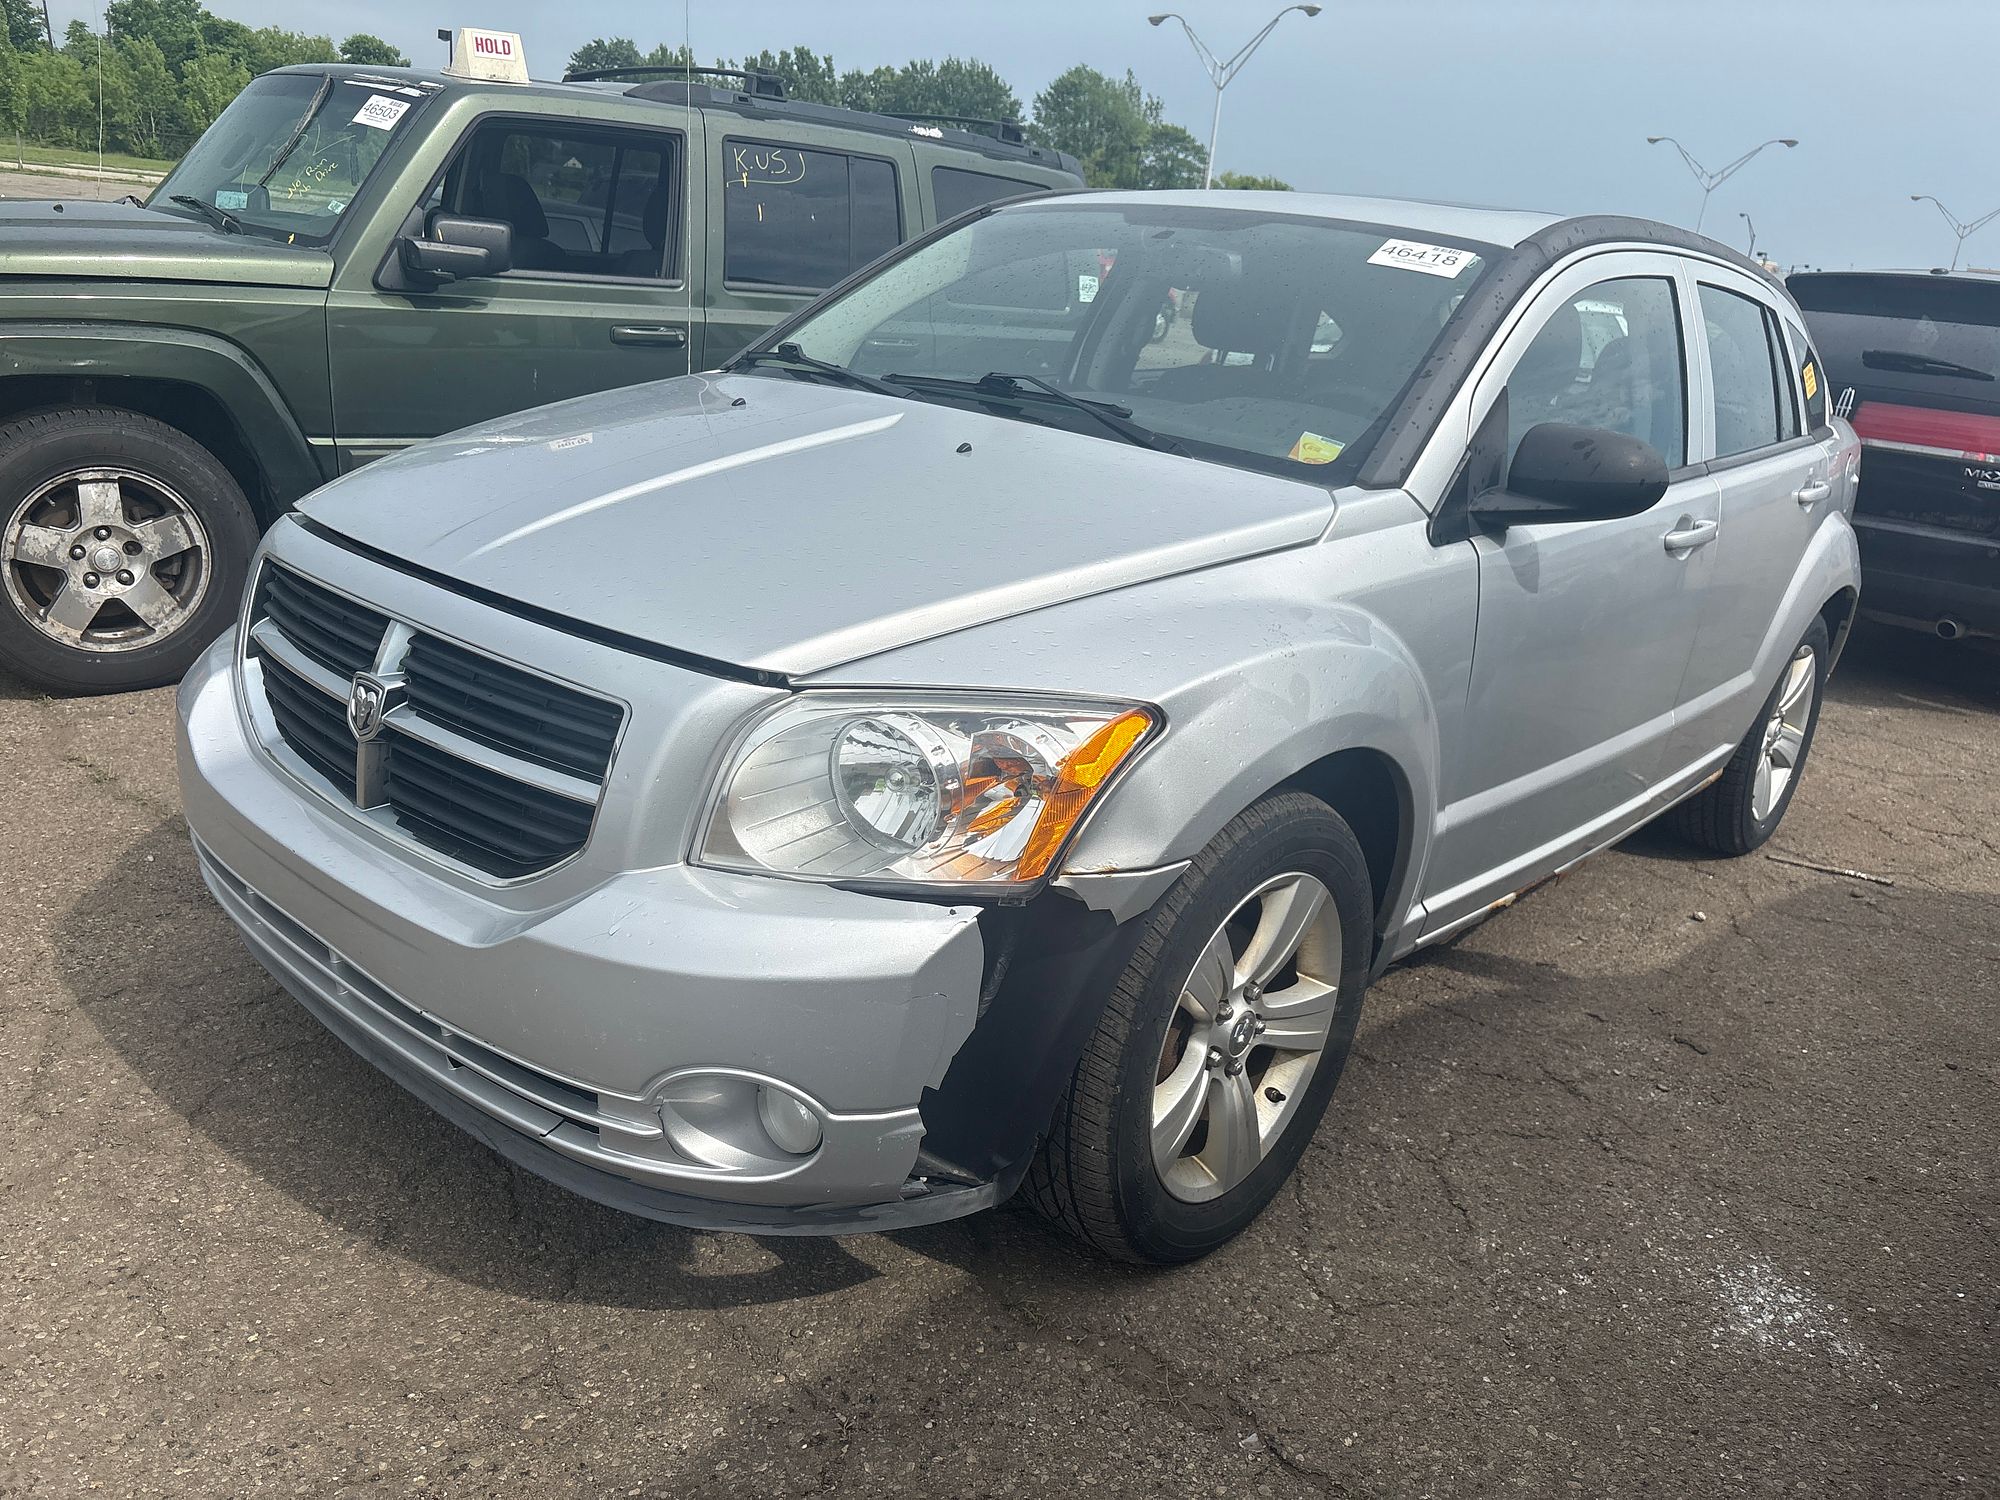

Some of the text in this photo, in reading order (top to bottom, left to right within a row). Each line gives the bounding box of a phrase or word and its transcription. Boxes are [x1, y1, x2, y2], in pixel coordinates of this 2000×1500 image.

[474, 36, 511, 55] HOLD
[363, 102, 400, 120] 46503
[1381, 245, 1459, 266] 46418
